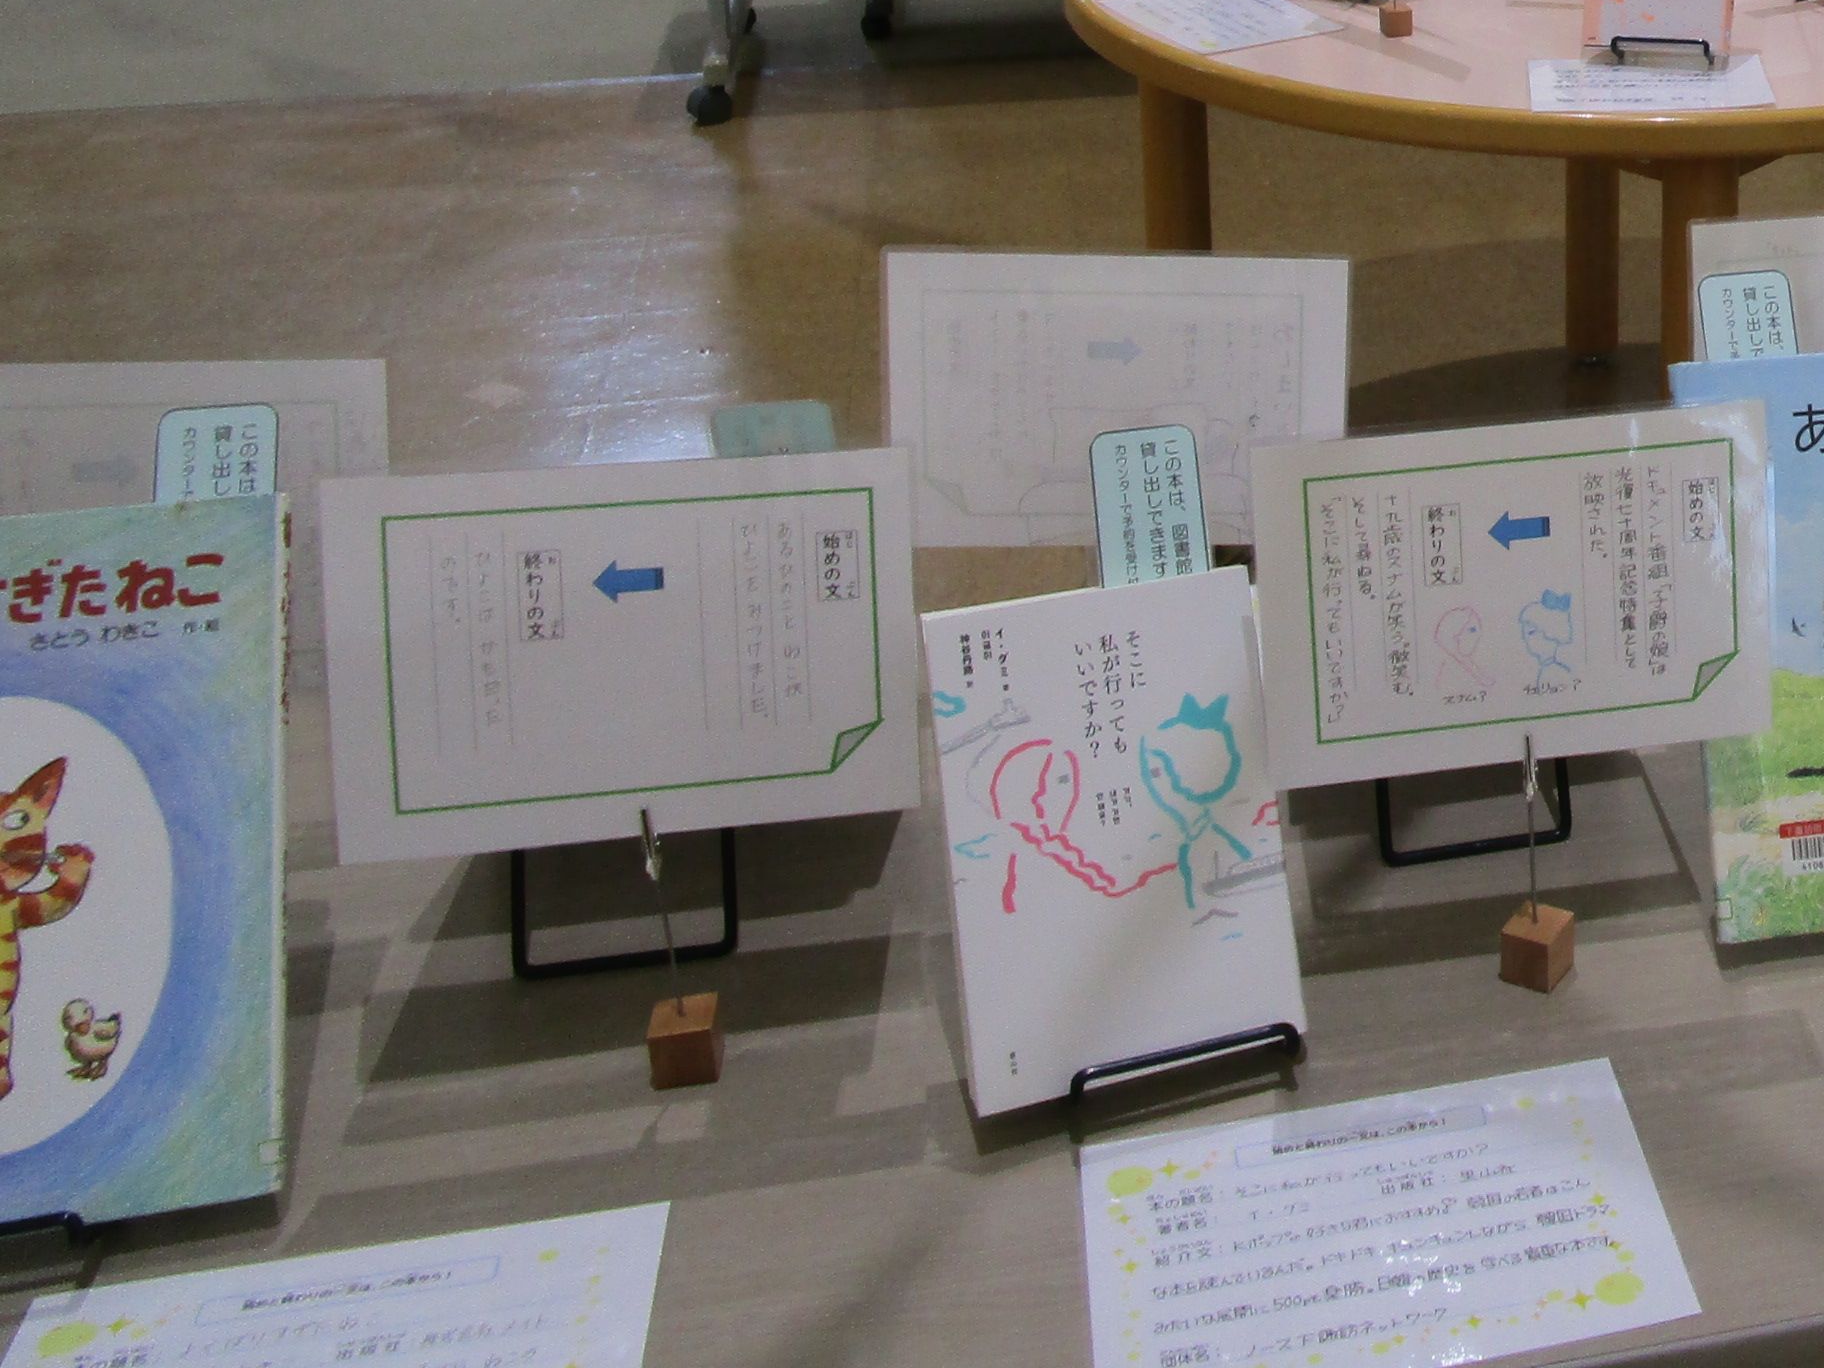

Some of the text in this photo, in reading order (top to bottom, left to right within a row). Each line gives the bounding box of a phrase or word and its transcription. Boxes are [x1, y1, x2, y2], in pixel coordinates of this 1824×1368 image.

[213, 424, 233, 496] 貸し出し
[237, 422, 260, 495] この本は
[1138, 441, 1169, 578] 貸し出しできます
[1161, 439, 1194, 578] この本は、図書館
[1426, 505, 1446, 585] 終わりの文
[1686, 479, 1705, 542] 始めの文
[0, 552, 225, 624] ぎたねこ
[523, 552, 545, 640] 終わりの文
[822, 532, 843, 600] 始めの文
[29, 626, 91, 652] さとう
[99, 619, 160, 644] わきこ
[1125, 629, 1147, 688] そこに
[1074, 641, 1100, 759] いいですか?
[1099, 633, 1128, 754] 私が行っても
